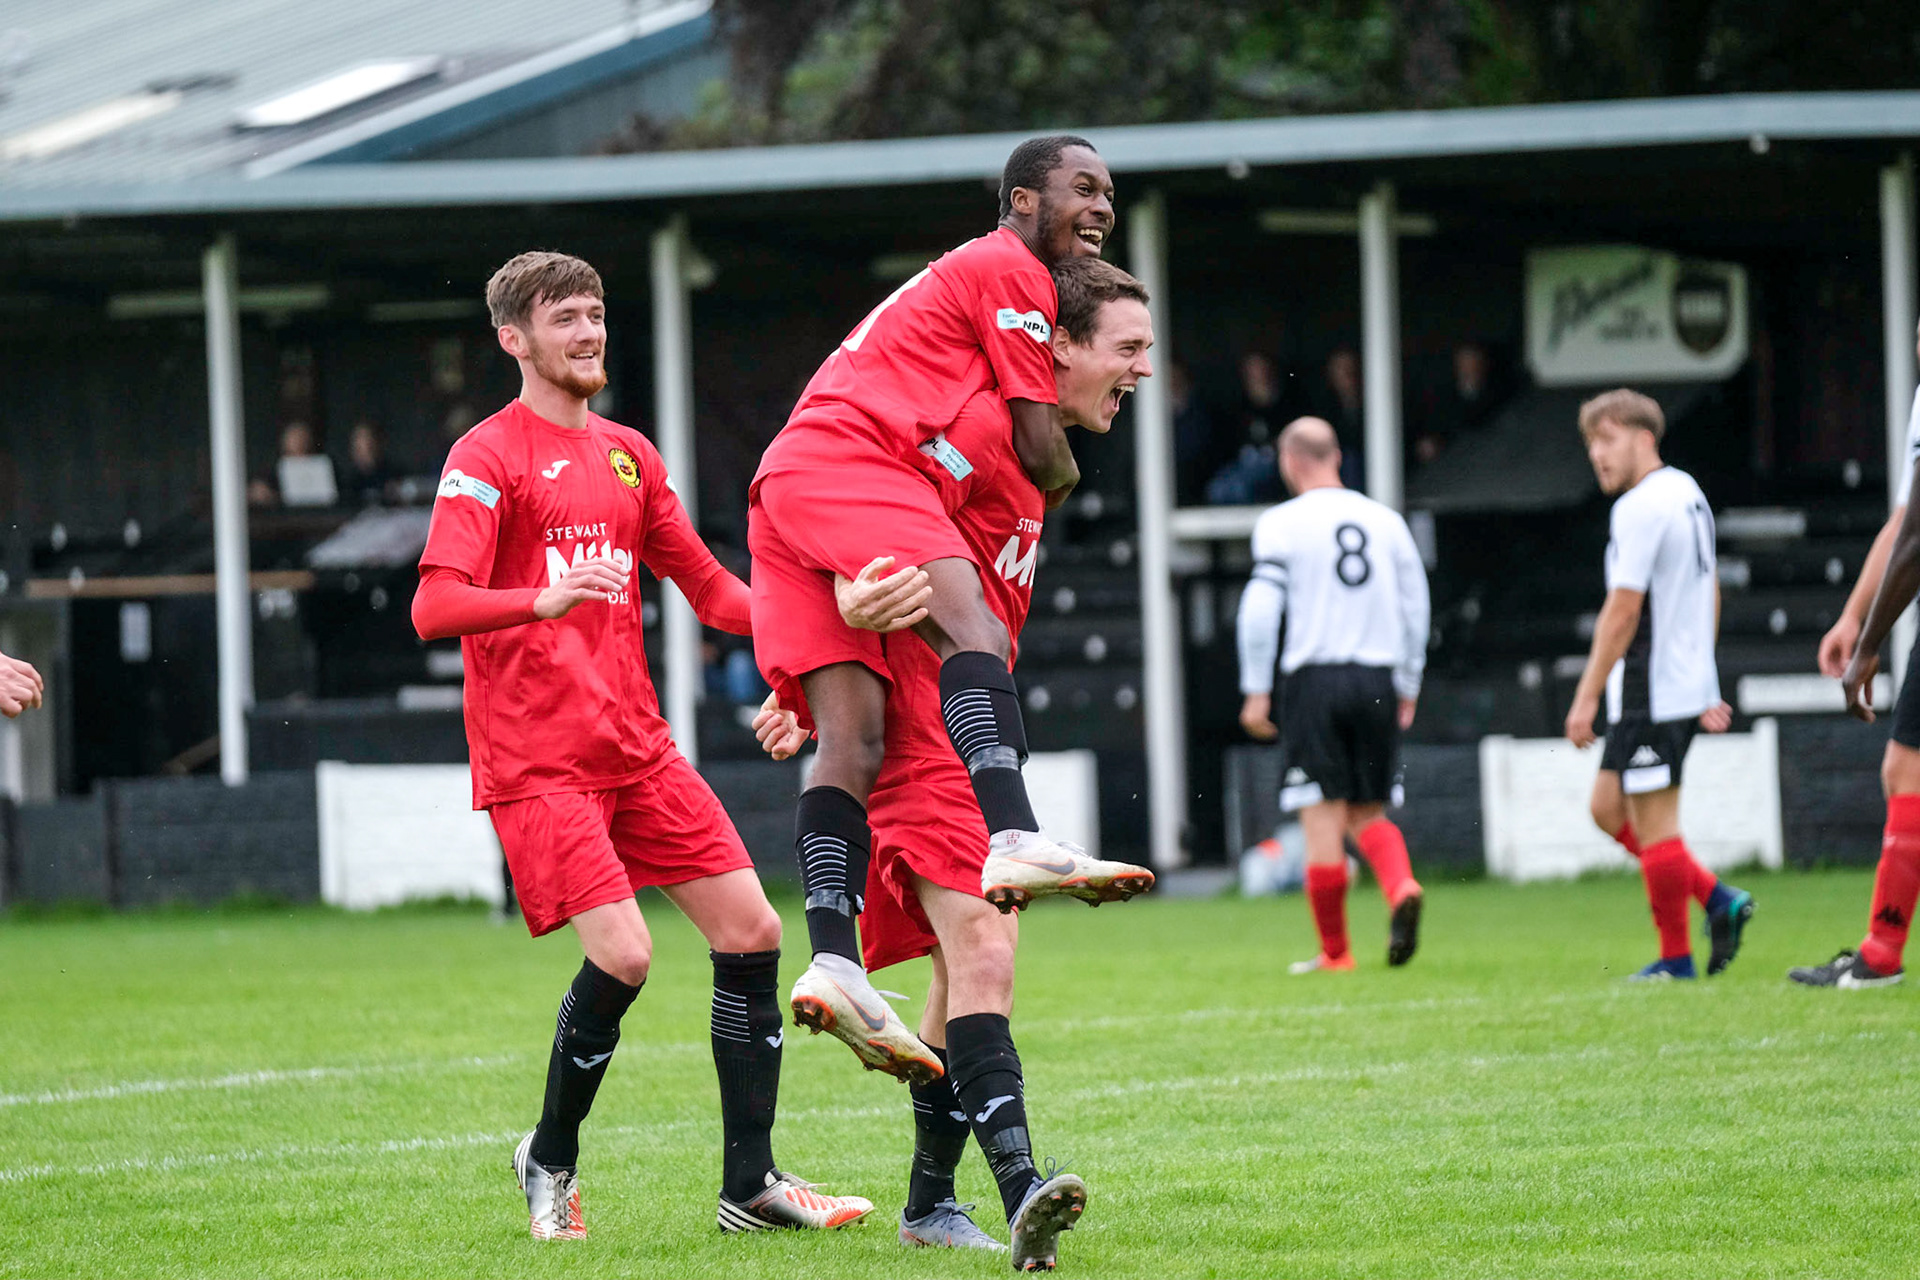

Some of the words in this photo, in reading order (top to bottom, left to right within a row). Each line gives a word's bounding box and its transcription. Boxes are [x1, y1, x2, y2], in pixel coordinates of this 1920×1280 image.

[1023, 320, 1047, 335] NPL
[924, 437, 939, 451] PL
[545, 522, 607, 541] STEWART
[1335, 523, 1371, 588] 8
